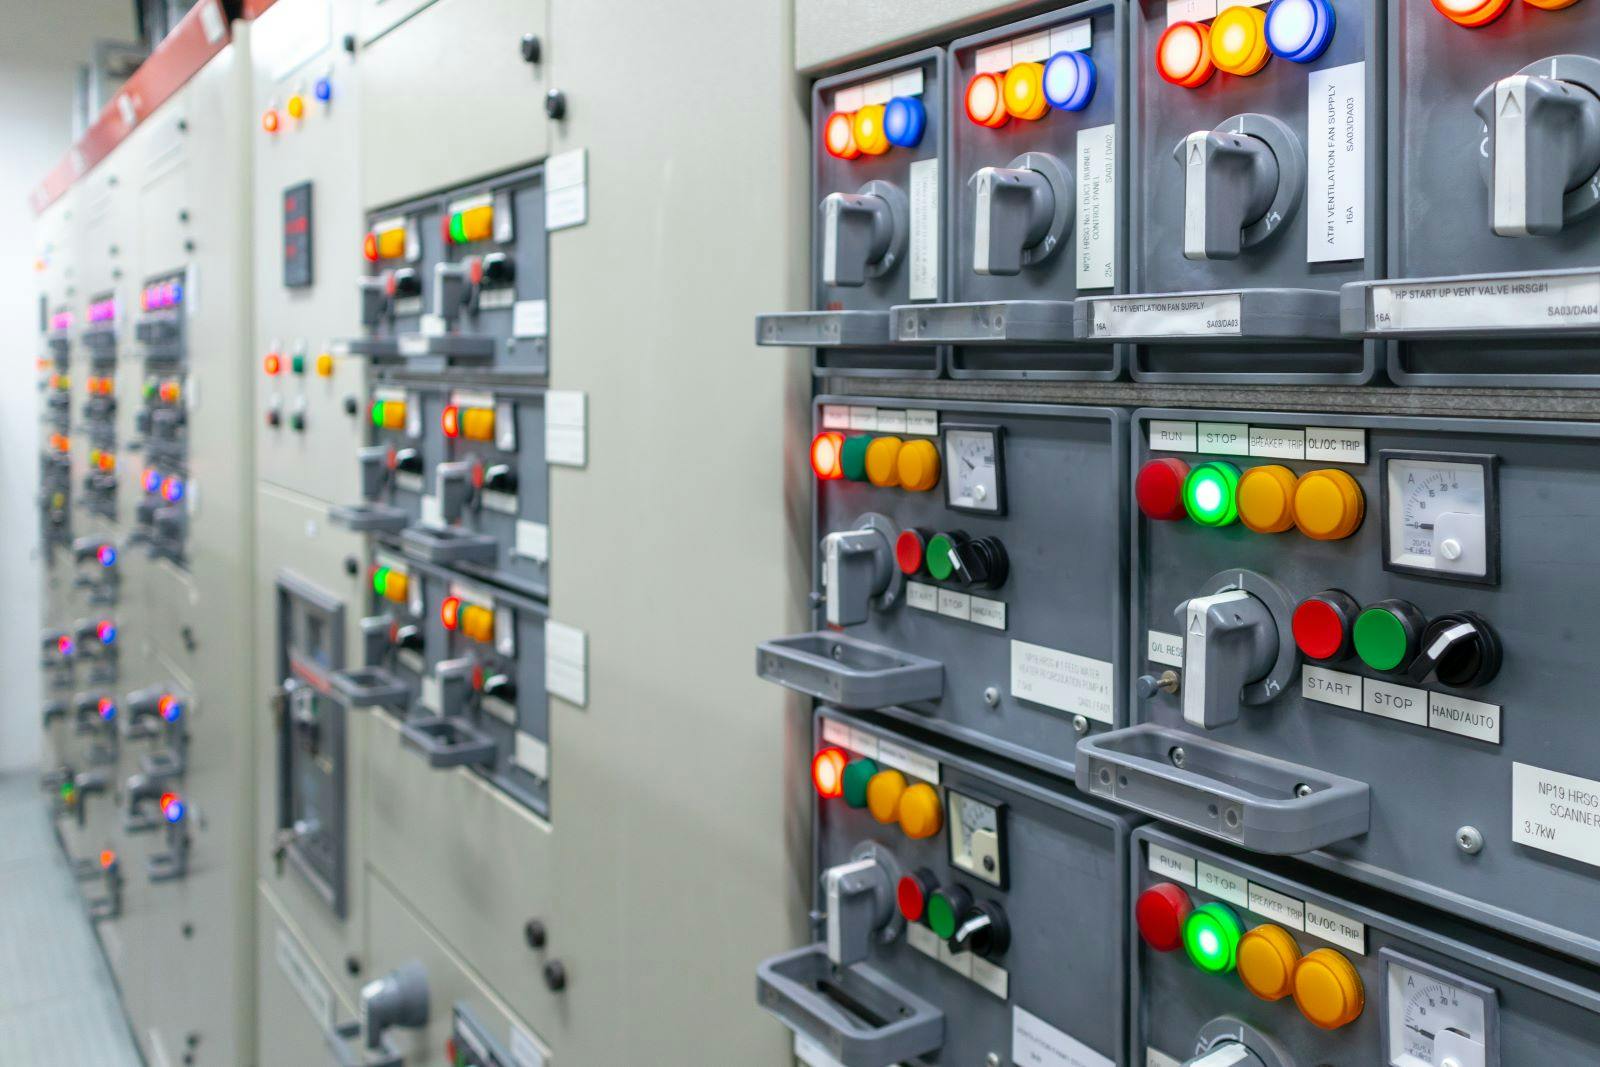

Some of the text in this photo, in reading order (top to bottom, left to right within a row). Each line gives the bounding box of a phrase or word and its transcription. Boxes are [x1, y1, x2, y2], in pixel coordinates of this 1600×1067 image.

[1328, 84, 1336, 244] AT#1 VENTILATION FAN SUPPLY
[1346, 97, 1354, 224] 16A SA03/DA03
[1092, 176, 1100, 240] CONTROL PANEL
[1395, 282, 1548, 299] HP START UP VENT VALVE HRSG#1
[1112, 302, 1205, 312] AT#1 VENTILATION FAN SUPPLY
[1376, 305, 1598, 322] 16A SA03/DA04
[1096, 319, 1239, 331] 16A SA03/DA03
[1160, 430, 1182, 441] RUN
[1206, 432, 1237, 444] STOP
[1250, 436, 1304, 450] BREAKER TRIP
[1308, 438, 1360, 450] OL/OC TRIP
[1408, 473, 1415, 484] A
[1420, 501, 1426, 509] 10
[1308, 676, 1352, 696] START
[1374, 692, 1413, 710] STOP
[1432, 704, 1494, 730] HAND/AUTO
[1538, 782, 1599, 808] NP19 HRSG
[1524, 820, 1556, 840] 3.7kW
[1160, 854, 1182, 872] RUN
[1206, 872, 1236, 892] STOP
[1250, 892, 1303, 920] BREAKER TRIP
[1307, 912, 1360, 940] OL/OC TRIP
[1408, 976, 1414, 988] A
